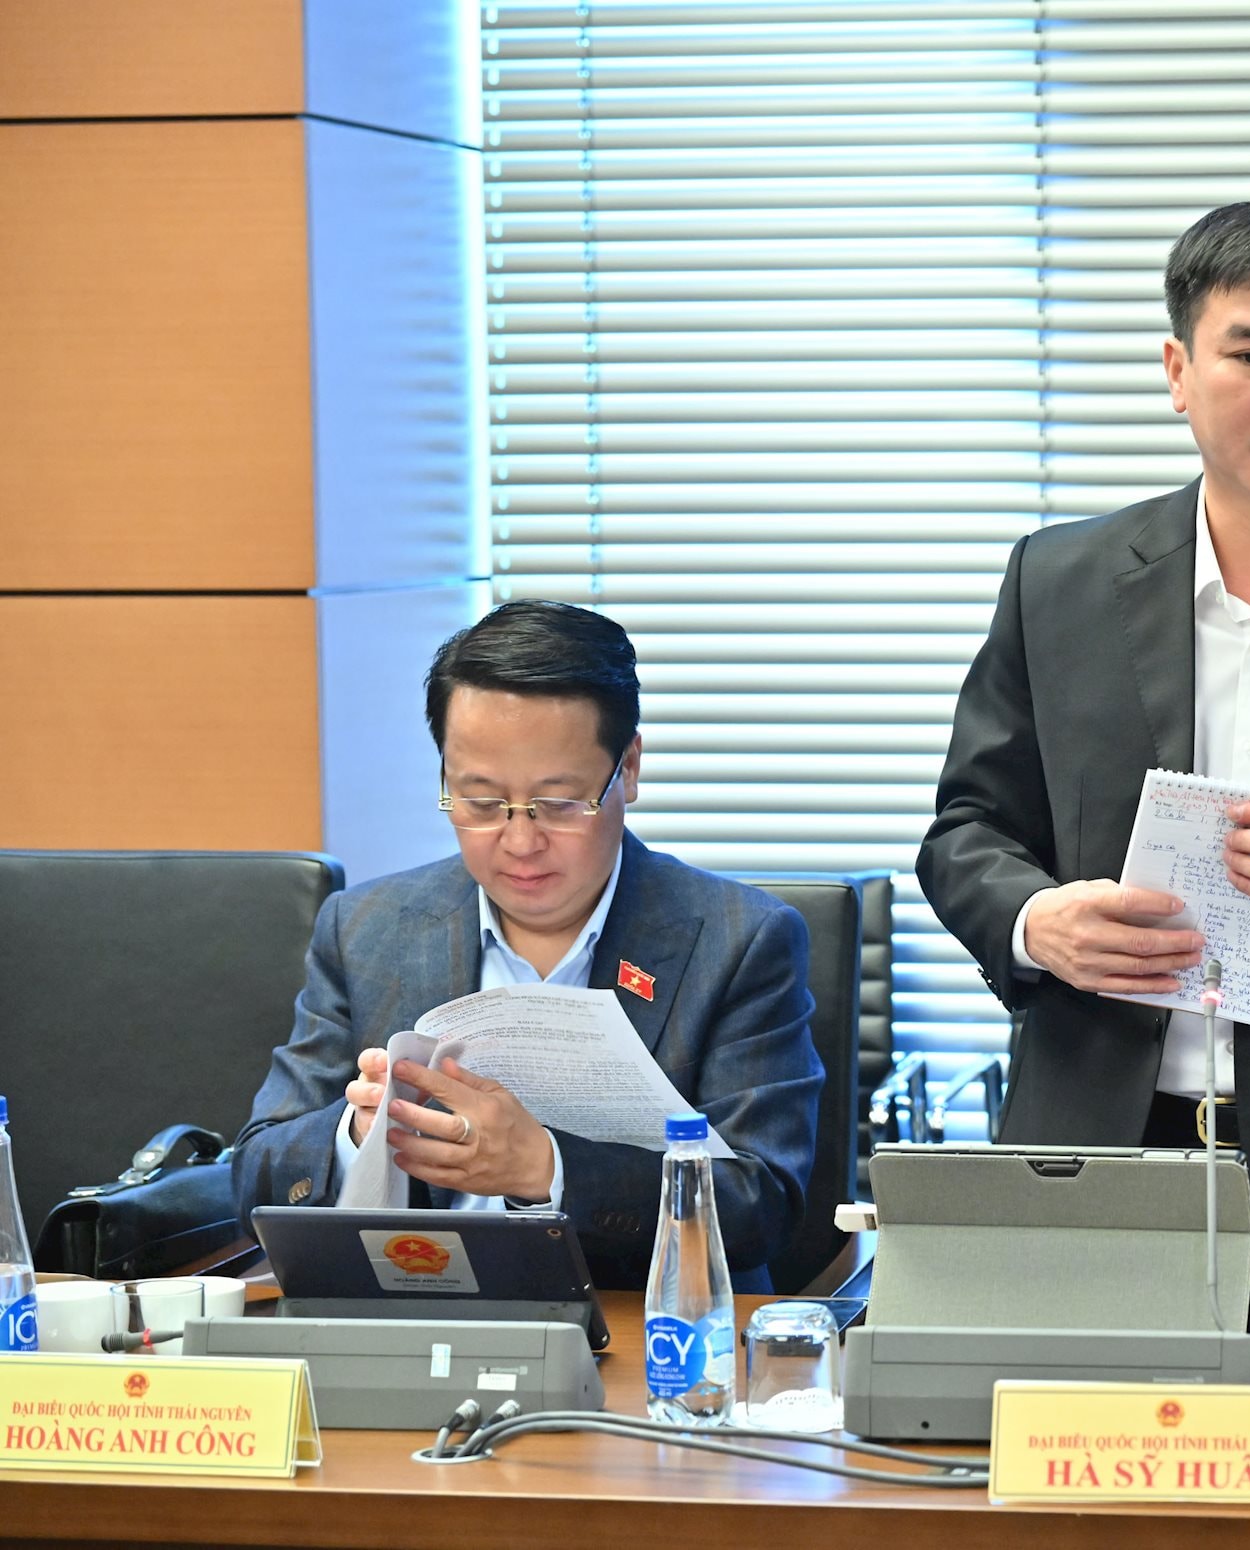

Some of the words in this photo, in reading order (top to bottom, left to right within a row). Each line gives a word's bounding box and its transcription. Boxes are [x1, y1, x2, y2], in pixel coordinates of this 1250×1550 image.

[646, 1329, 696, 1366] ICY
[12, 1402, 34, 1415] ĐẠI
[69, 1402, 104, 1418] QUỐC
[107, 1403, 131, 1420] HỘI
[134, 1402, 164, 1419] TỈNH
[168, 1405, 197, 1420] THÁI
[200, 1406, 251, 1421] NGUYÊN
[5, 1419, 104, 1452] HOÀNG
[109, 1429, 168, 1453] ANH
[176, 1424, 256, 1457] CÔNG
[1028, 1436, 1055, 1450] ĐẠI
[1095, 1435, 1136, 1451] QUỐC
[1141, 1436, 1169, 1452] HỘI
[1212, 1436, 1248, 1451] THÁI
[1046, 1452, 1101, 1487] HÀ
[1113, 1454, 1162, 1488] SỸ
